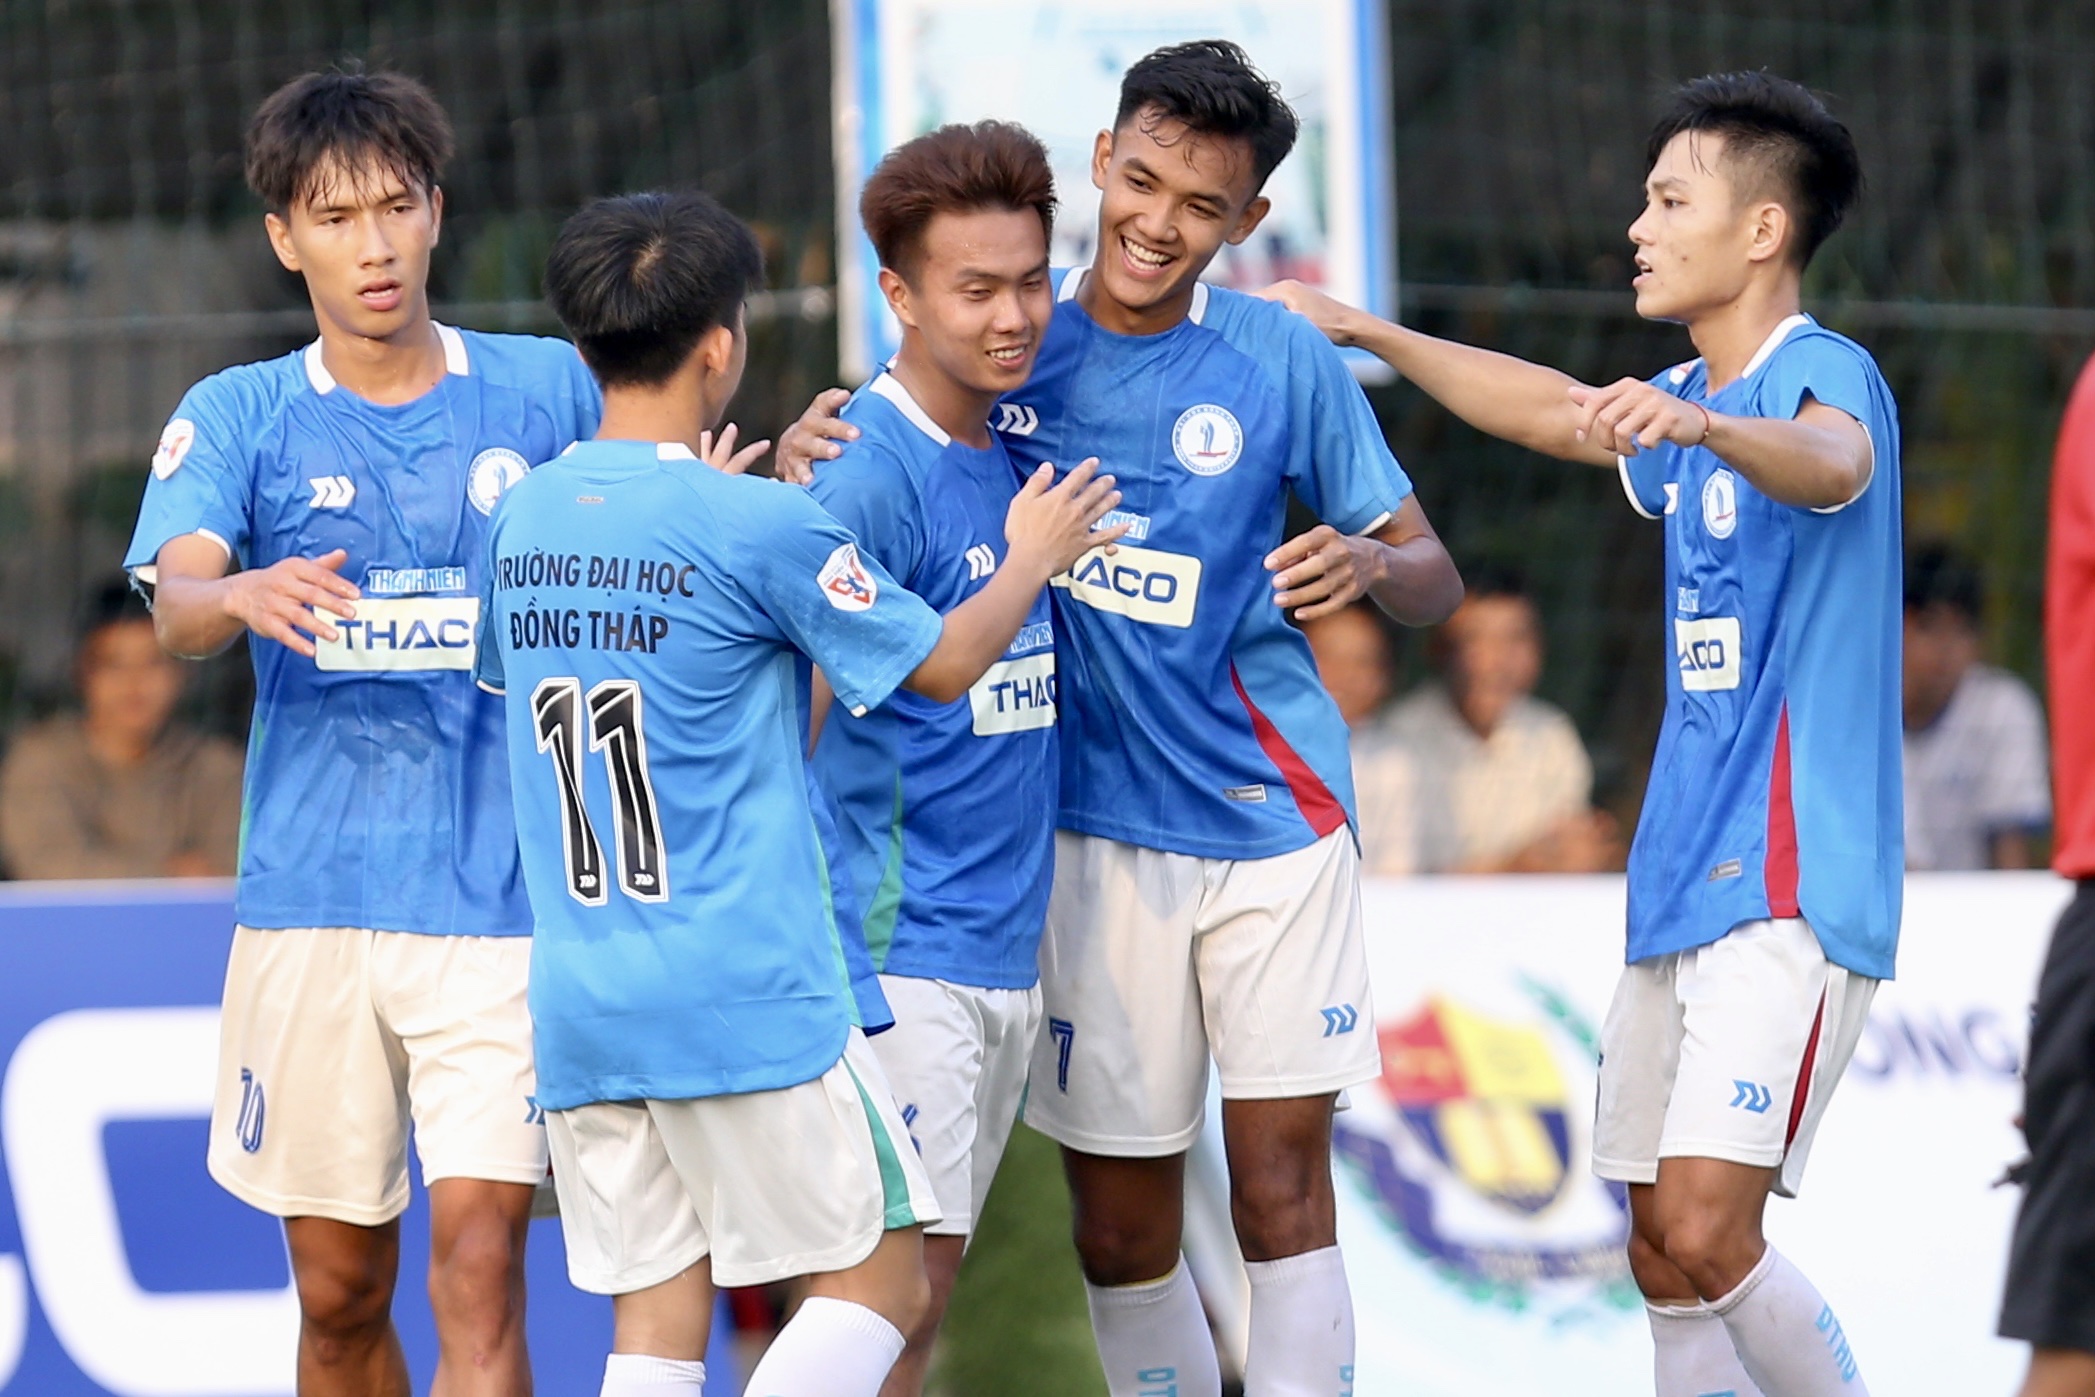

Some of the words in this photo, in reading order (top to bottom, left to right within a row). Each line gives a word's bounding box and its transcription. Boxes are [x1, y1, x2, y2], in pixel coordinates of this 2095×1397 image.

[587, 555, 630, 597] ĐẠI
[636, 559, 696, 603] HỌC
[1076, 555, 1178, 604] ACO
[335, 618, 478, 650] THAC
[510, 595, 580, 650] ĐỒNG
[587, 605, 669, 654] THÁP
[1680, 639, 1725, 671] ACO
[530, 676, 670, 907] 11
[1049, 1015, 1075, 1096] 7
[235, 1066, 266, 1154] 10
